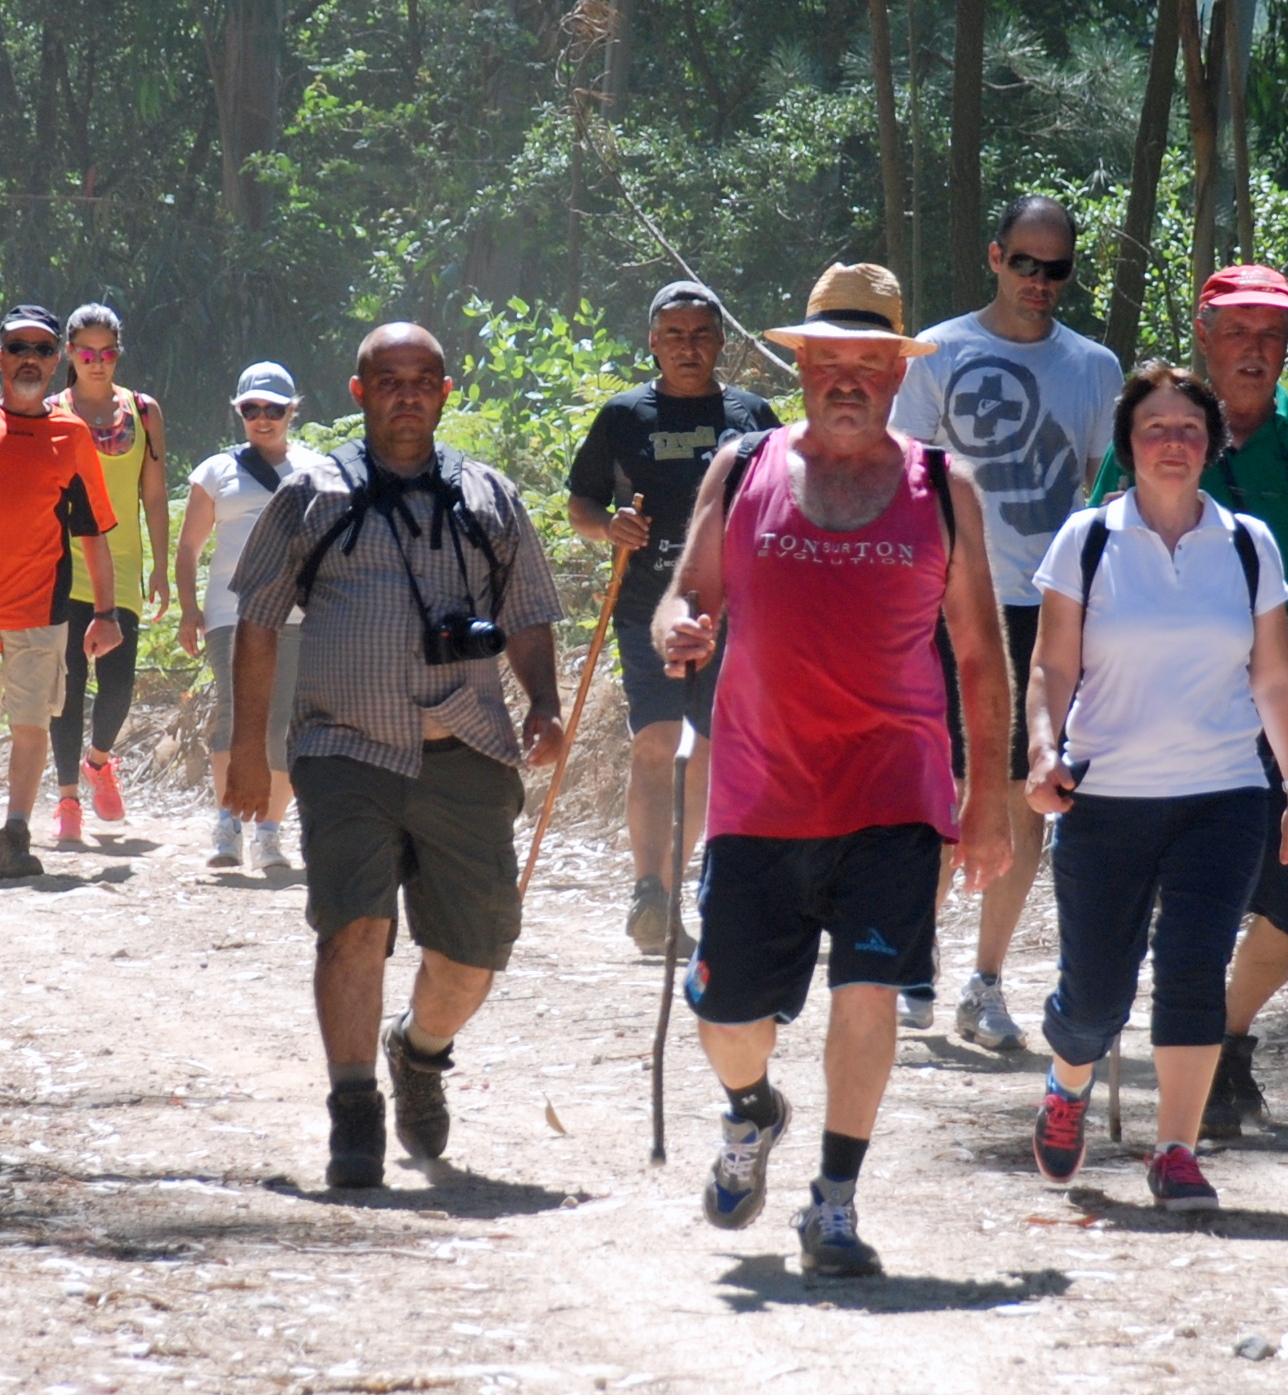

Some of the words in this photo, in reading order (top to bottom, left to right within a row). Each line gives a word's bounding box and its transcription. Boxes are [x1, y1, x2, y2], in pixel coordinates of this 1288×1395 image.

[760, 533, 819, 553] TON
[822, 542, 850, 553] SUR
[855, 541, 914, 559] TON
[758, 550, 914, 567] EVOLUTION
